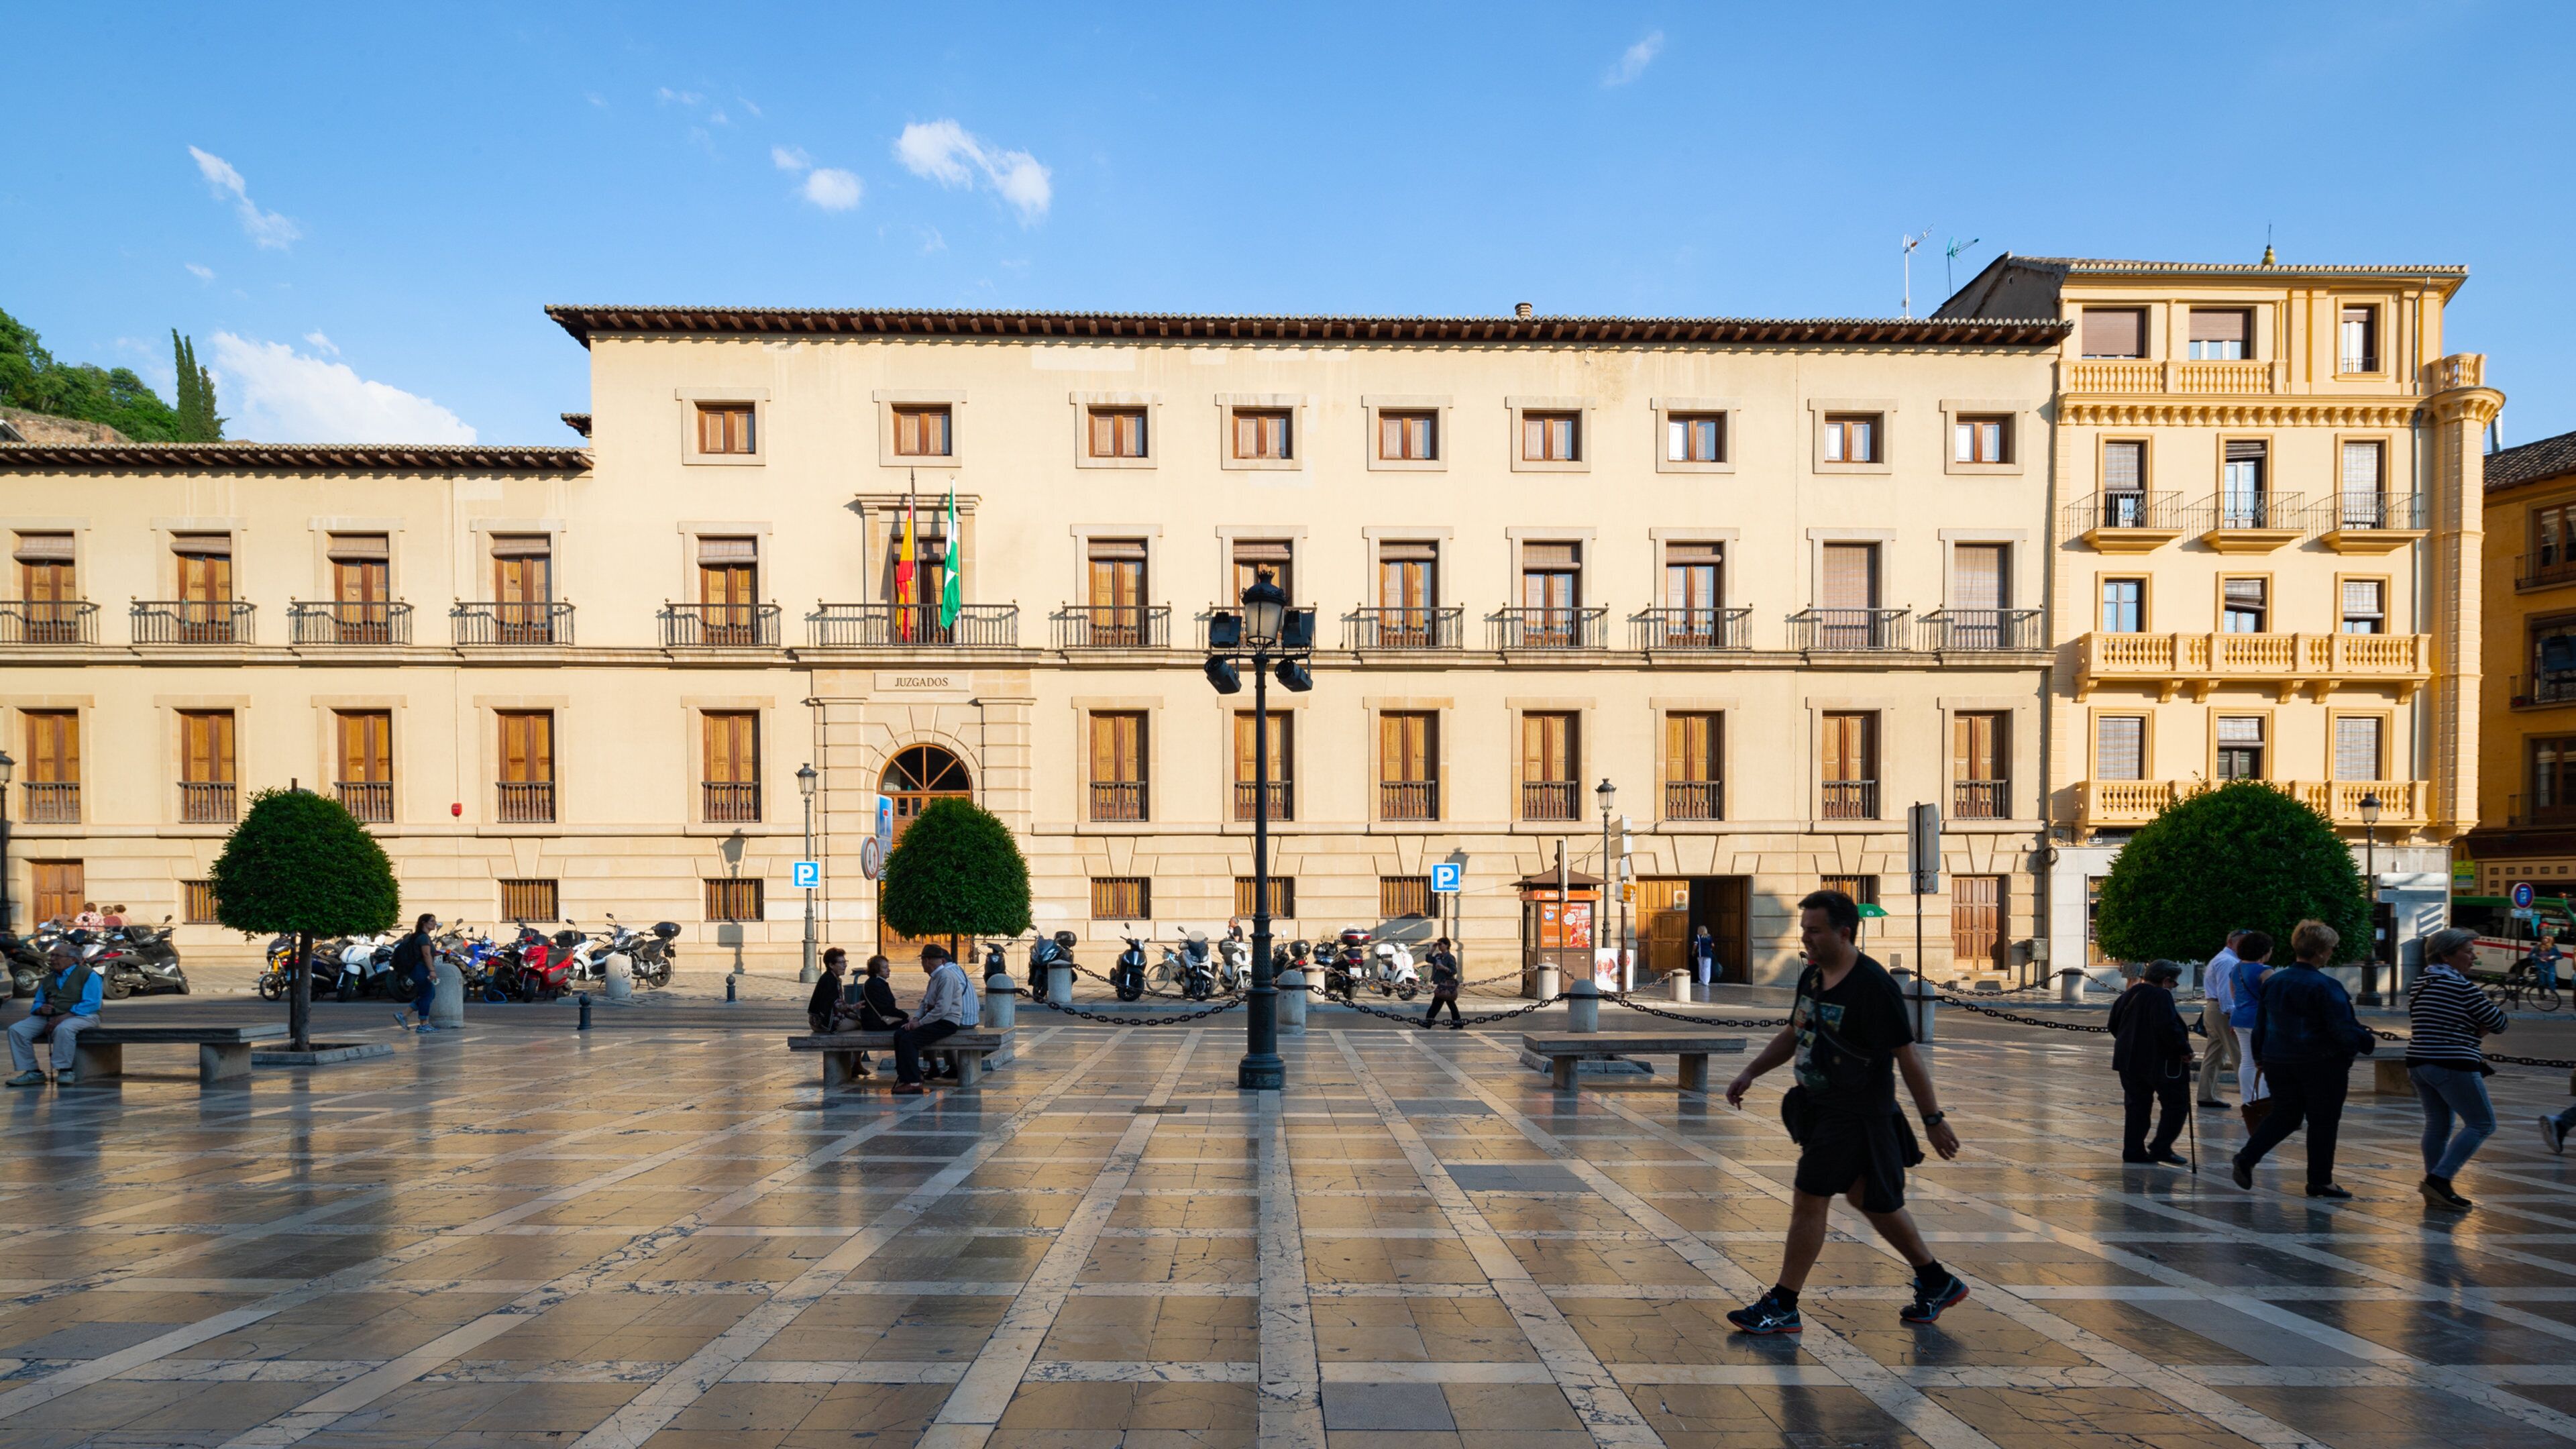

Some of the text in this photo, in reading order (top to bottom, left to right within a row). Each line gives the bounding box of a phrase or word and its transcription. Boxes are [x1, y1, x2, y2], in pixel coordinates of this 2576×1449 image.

[895, 677, 949, 687] JUZGADOS
[798, 865, 814, 885] P
[1437, 867, 1454, 889] P
